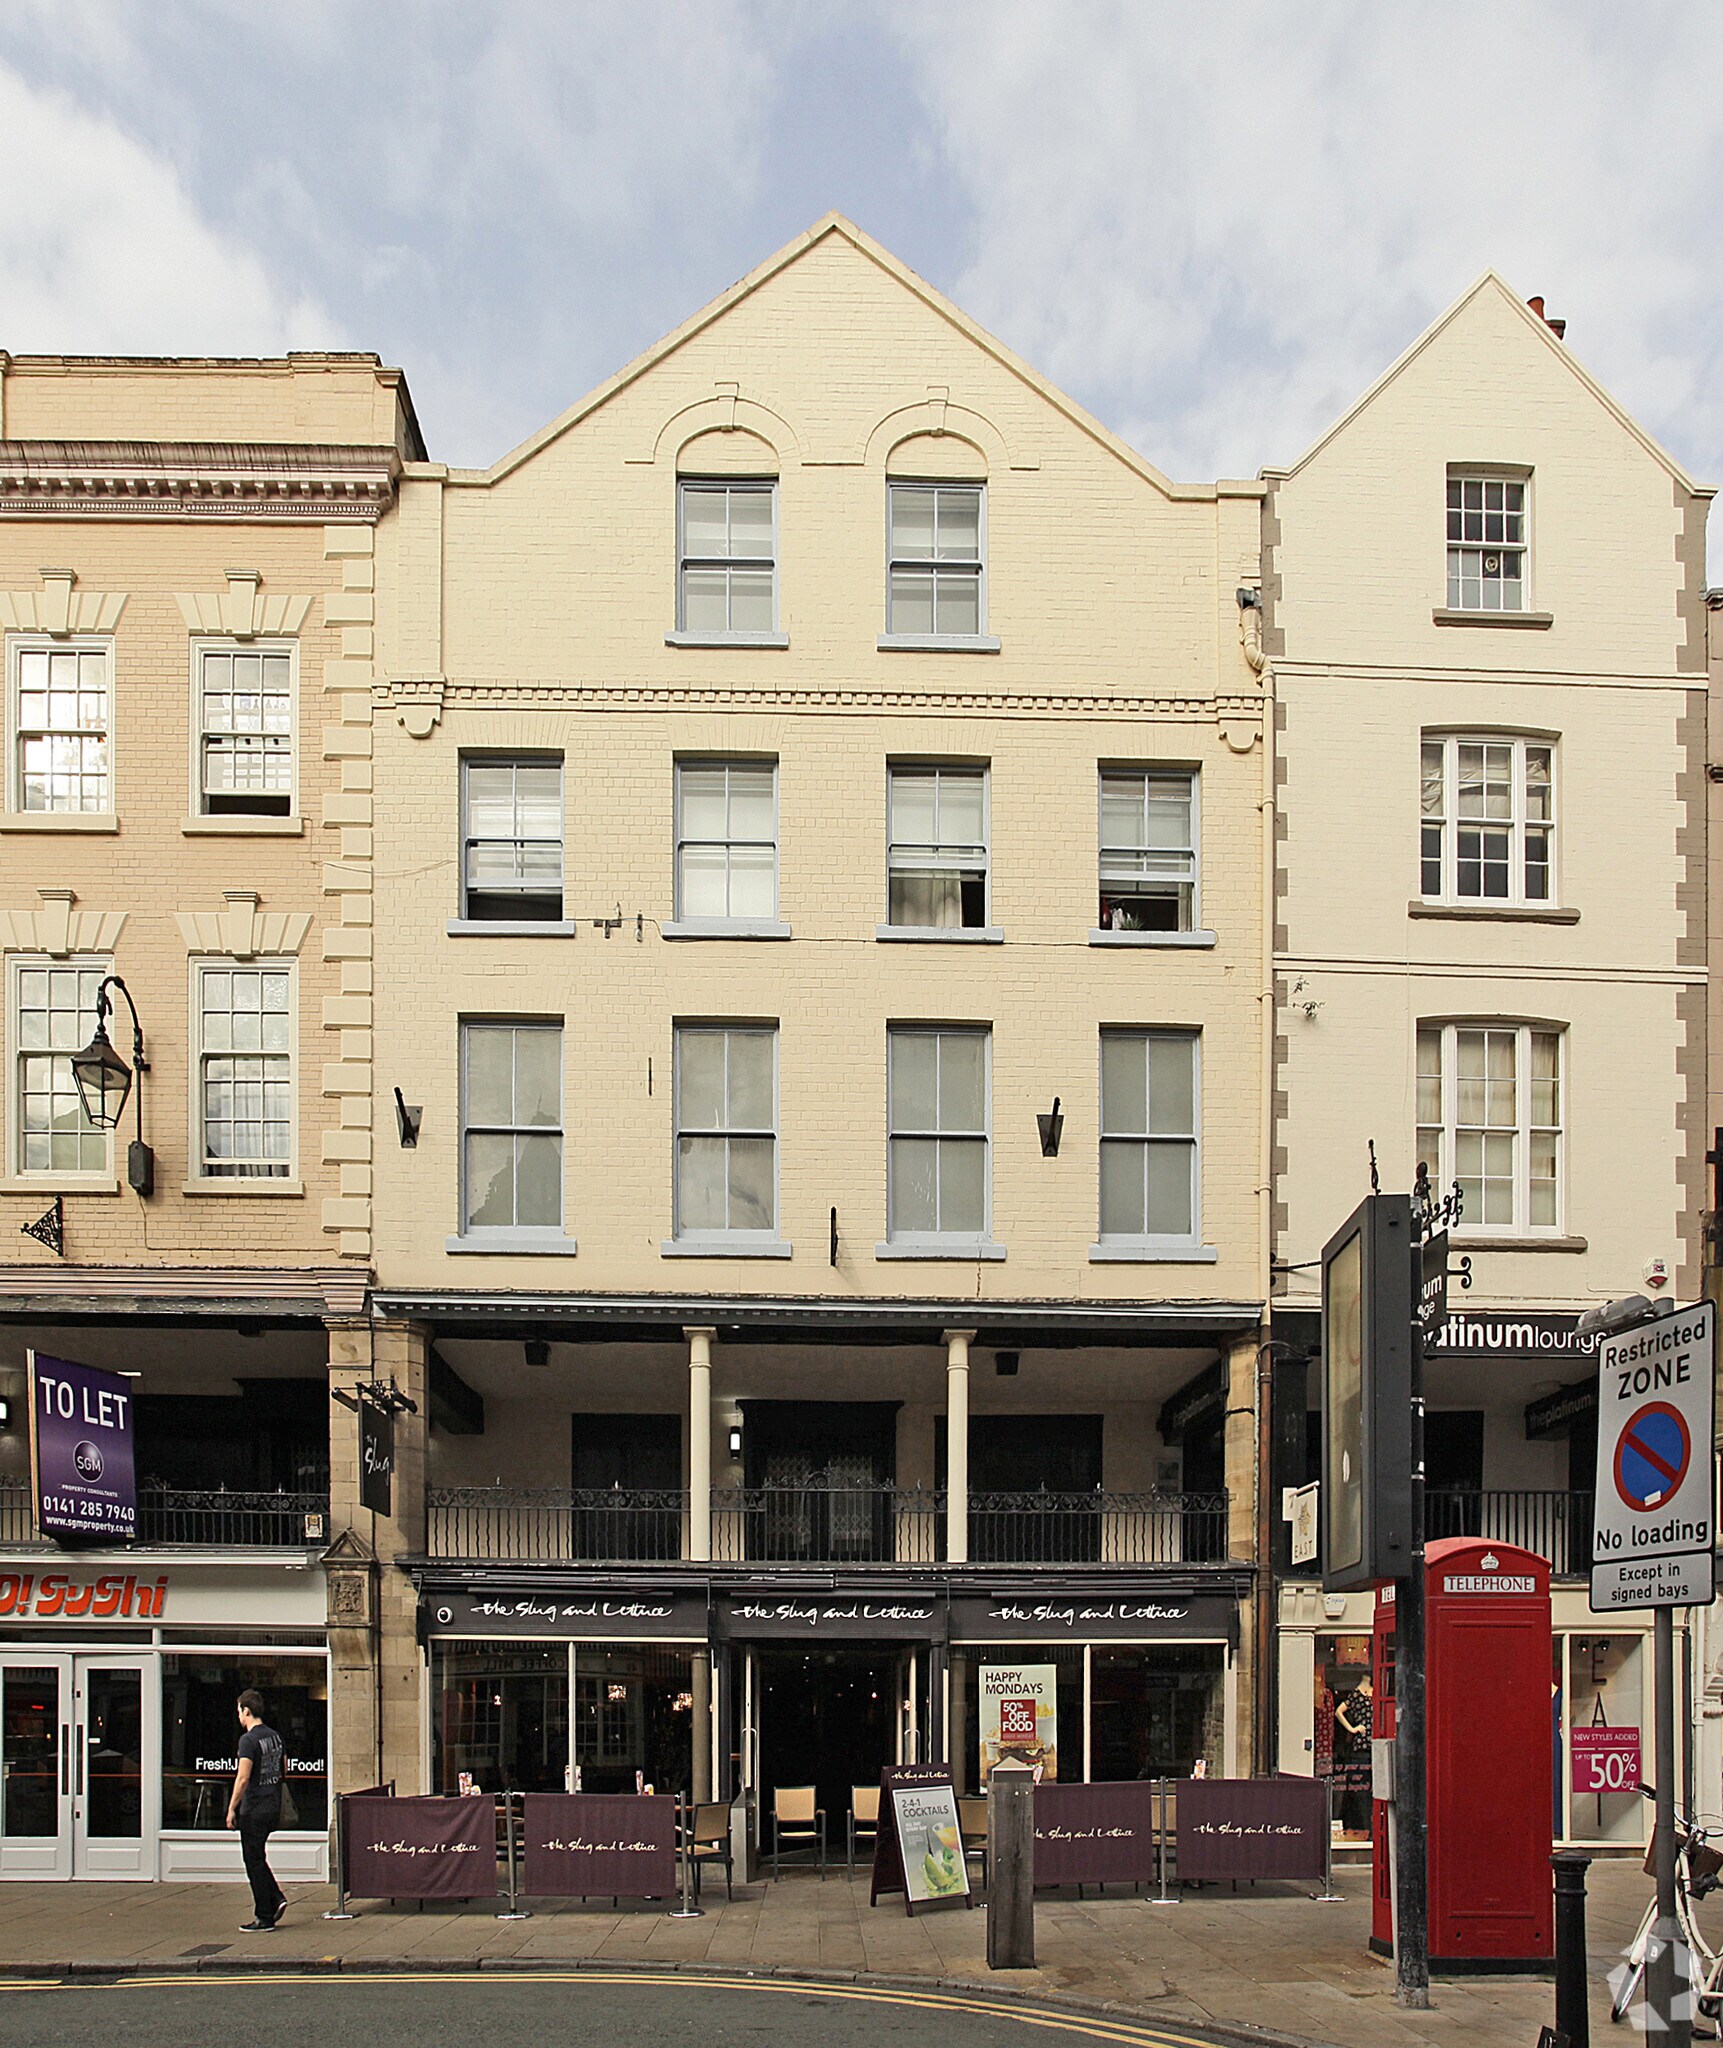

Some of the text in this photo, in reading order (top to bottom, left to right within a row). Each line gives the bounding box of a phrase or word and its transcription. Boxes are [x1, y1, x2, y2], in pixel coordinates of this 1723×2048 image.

[1606, 1315, 1706, 1369] Restricted
[1617, 1353, 1691, 1400] ZONE
[39, 1376, 128, 1430] TO LET
[77, 1456, 102, 1472] SGM
[43, 1496, 135, 1521] 0141 285 7940
[45, 1515, 135, 1534] www.sgmproperty.co.uk
[1596, 1518, 1708, 1551] No loading
[1294, 1540, 1313, 1559] EAST
[1619, 1562, 1681, 1581] Except in
[1448, 1576, 1532, 1591] TELEPHONE
[1611, 1583, 1689, 1603] signed bays
[470, 1596, 673, 1623] the Slug and Lettuce
[730, 1599, 934, 1626] the Slug and Lettuce
[988, 1600, 1189, 1627] the Slug and Lettuce
[985, 1671, 1023, 1683] HAPPY
[985, 1683, 1044, 1695] MONDAYS
[1003, 1702, 1024, 1713] 50%
[1008, 1711, 1030, 1722] OFF
[1002, 1721, 1034, 1732] FOOD
[1589, 1752, 1637, 1790] 50%
[1621, 1780, 1636, 1789] OFF
[901, 1798, 921, 1808] 2-4-1
[903, 1804, 950, 1818] COCKTAILS
[1033, 1828, 1047, 1839] he
[1048, 1825, 1072, 1842] Slug
[1074, 1827, 1095, 1838] and
[1193, 1822, 1218, 1834] the
[1218, 1821, 1242, 1838] Slug
[1244, 1824, 1265, 1834] and
[366, 1841, 391, 1853] the
[391, 1840, 416, 1858] Slug
[418, 1843, 438, 1854] and
[542, 1838, 568, 1851] the
[568, 1837, 593, 1855] Slug
[595, 1841, 616, 1851] and
